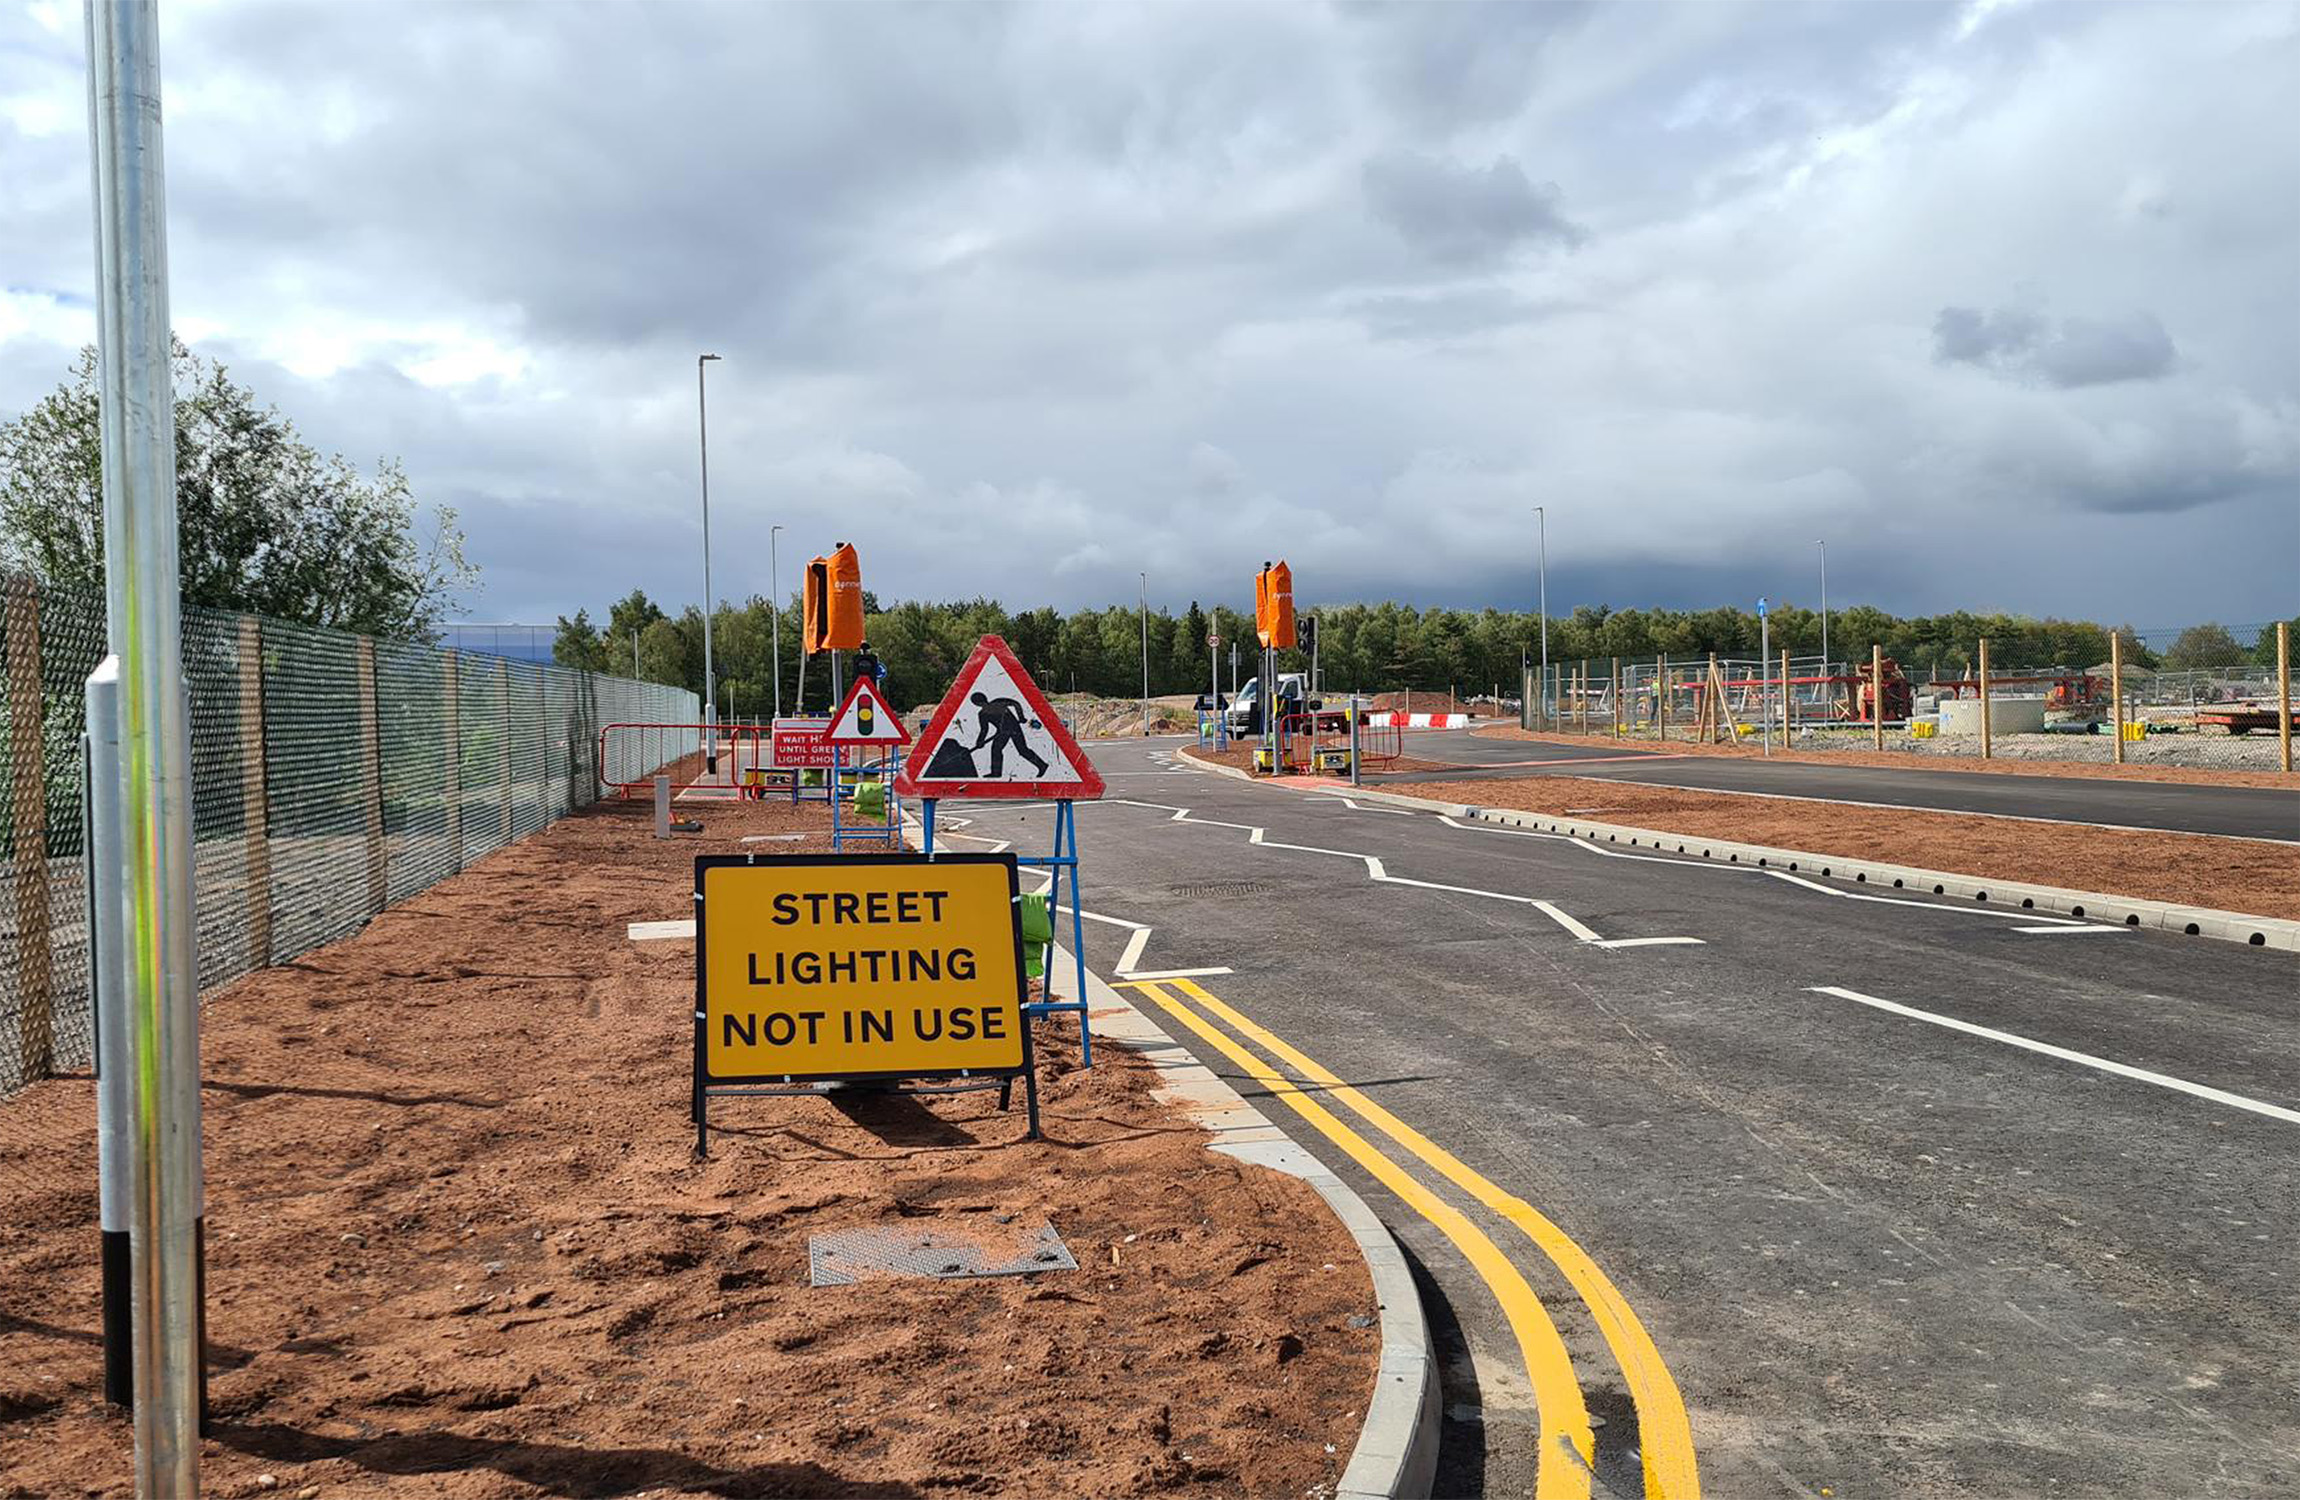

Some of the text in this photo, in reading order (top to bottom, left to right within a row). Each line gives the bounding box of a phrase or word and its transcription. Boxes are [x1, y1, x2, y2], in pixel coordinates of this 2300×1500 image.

[777, 755, 806, 763] LIGHT
[779, 745, 808, 753] UNTIL
[771, 890, 949, 926] STREET
[748, 948, 977, 985] LIGHTING
[723, 1006, 1007, 1047] NOT IN USE
